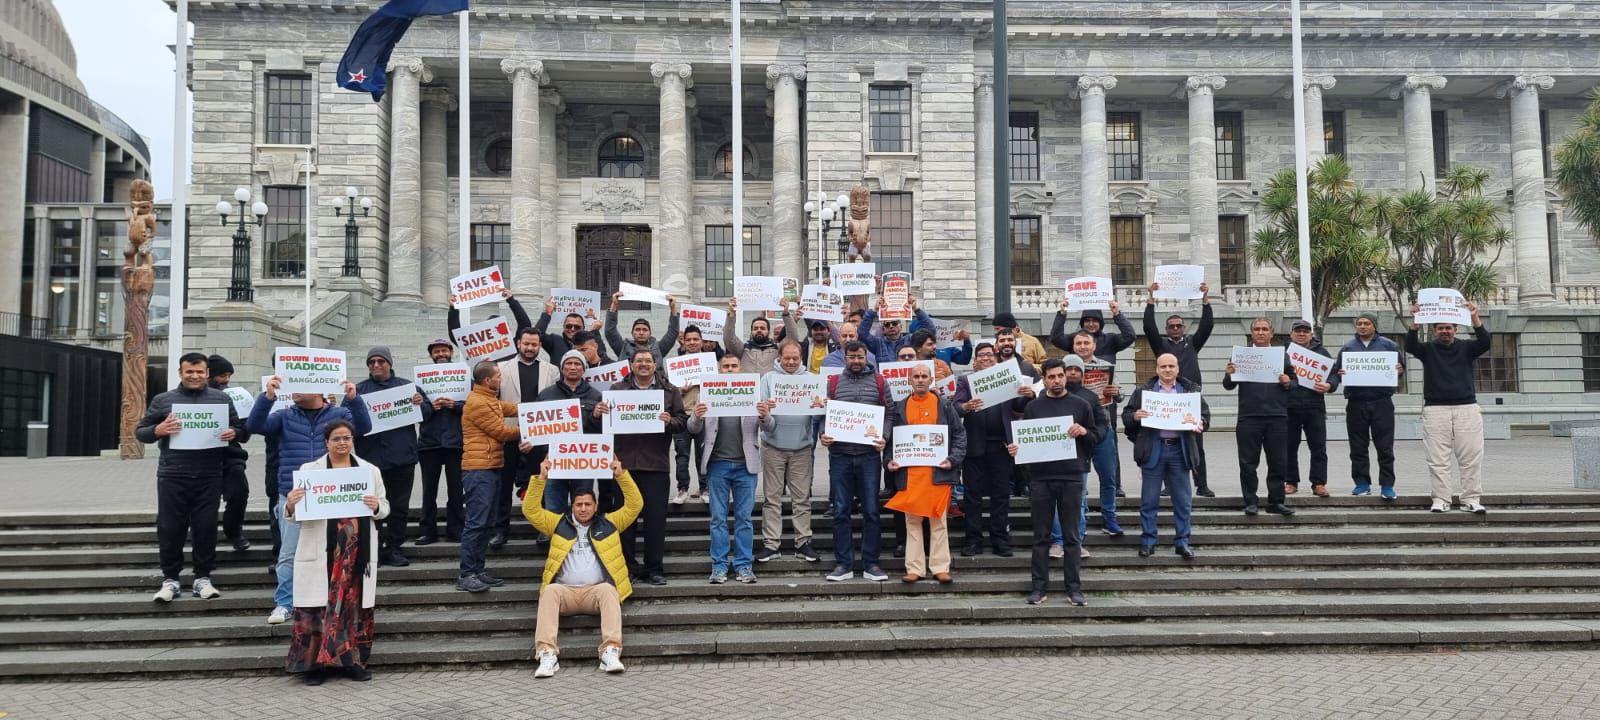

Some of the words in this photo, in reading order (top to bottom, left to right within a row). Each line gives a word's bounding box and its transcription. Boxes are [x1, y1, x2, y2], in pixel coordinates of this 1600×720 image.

[457, 276, 488, 292] SAVE
[1068, 281, 1097, 292] SAVE
[459, 285, 502, 302] HINDUS
[682, 309, 711, 320] SAVE
[461, 329, 494, 346] SAVE
[466, 338, 510, 358] HINDUS
[279, 354, 309, 362] DOWN
[313, 356, 341, 364] DOWN
[670, 358, 700, 370] SAVE
[1291, 352, 1320, 369] SAVE
[285, 362, 340, 371] RADICALS
[677, 367, 702, 376] HINDUS
[422, 375, 465, 384] RADICALS
[973, 374, 996, 387] SPEAK
[996, 368, 1010, 379] OUT
[1295, 365, 1323, 383] NDUS
[775, 382, 799, 390] HINDUS
[974, 384, 989, 395] FOR
[990, 375, 1017, 389] HINDUS
[708, 387, 755, 395] RADICALS
[792, 390, 811, 398] RIGHT
[372, 402, 391, 412] STOP
[394, 397, 413, 407] HIND
[638, 403, 661, 411] HINDU
[194, 412, 213, 420] OUT
[377, 405, 414, 419] GENOCIDE
[526, 409, 564, 423] SAVE
[620, 412, 657, 420] GENOCIDE
[829, 408, 854, 417] HINDUS
[858, 411, 875, 419] HAVE
[184, 421, 219, 429] HINDUS
[846, 417, 866, 425] RIGHT
[528, 421, 578, 436] HINDUS
[1017, 426, 1043, 436] SPEAK
[1044, 425, 1061, 433] OUT
[1018, 436, 1034, 444] FOR
[1035, 433, 1067, 443] HINDUS
[559, 443, 598, 453] SAVE
[553, 457, 609, 470] HINDUS
[312, 484, 336, 494] STOP
[340, 482, 368, 492] HINDU
[317, 493, 363, 505] GENOCIDE
